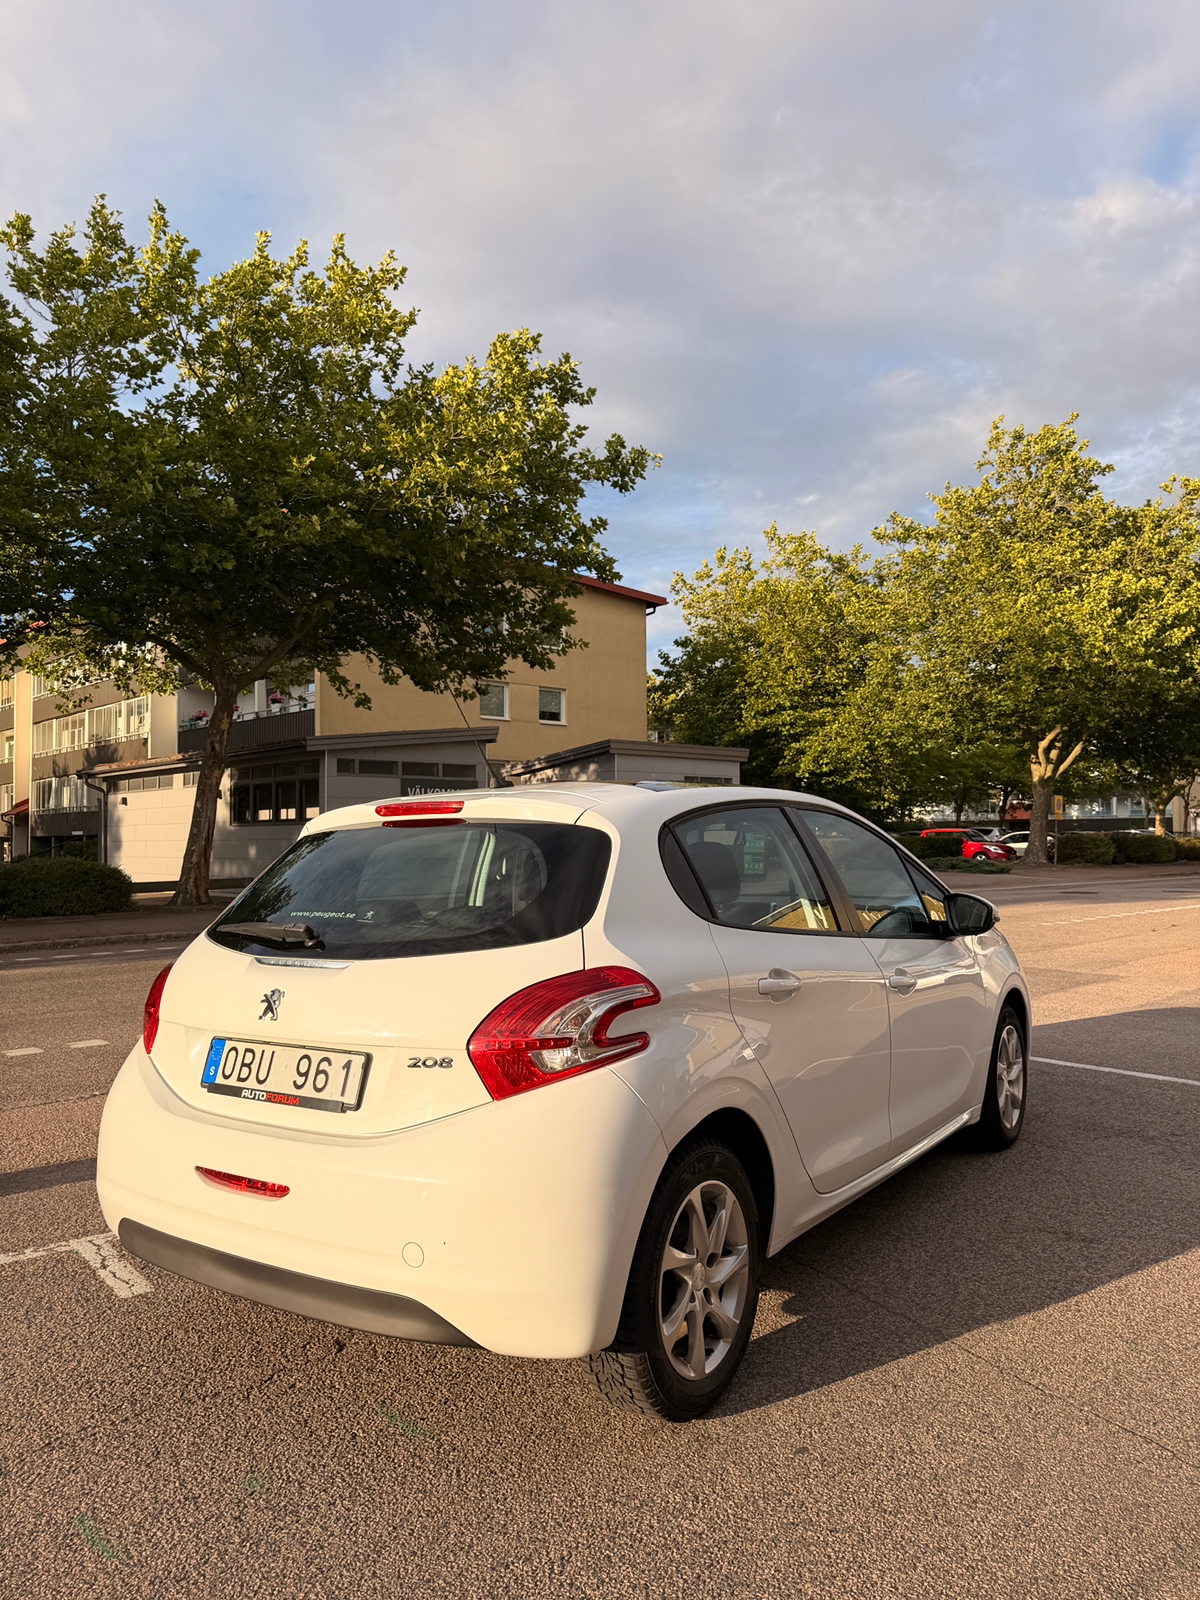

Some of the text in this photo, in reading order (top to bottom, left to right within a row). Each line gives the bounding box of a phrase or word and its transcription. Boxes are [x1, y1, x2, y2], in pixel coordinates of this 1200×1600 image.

[290, 910, 356, 919] www.peugeot.se
[407, 1056, 454, 1069] 208
[209, 1066, 216, 1076] S
[222, 1046, 353, 1097] OBU 961
[241, 1088, 300, 1106] AUTOFORUM
